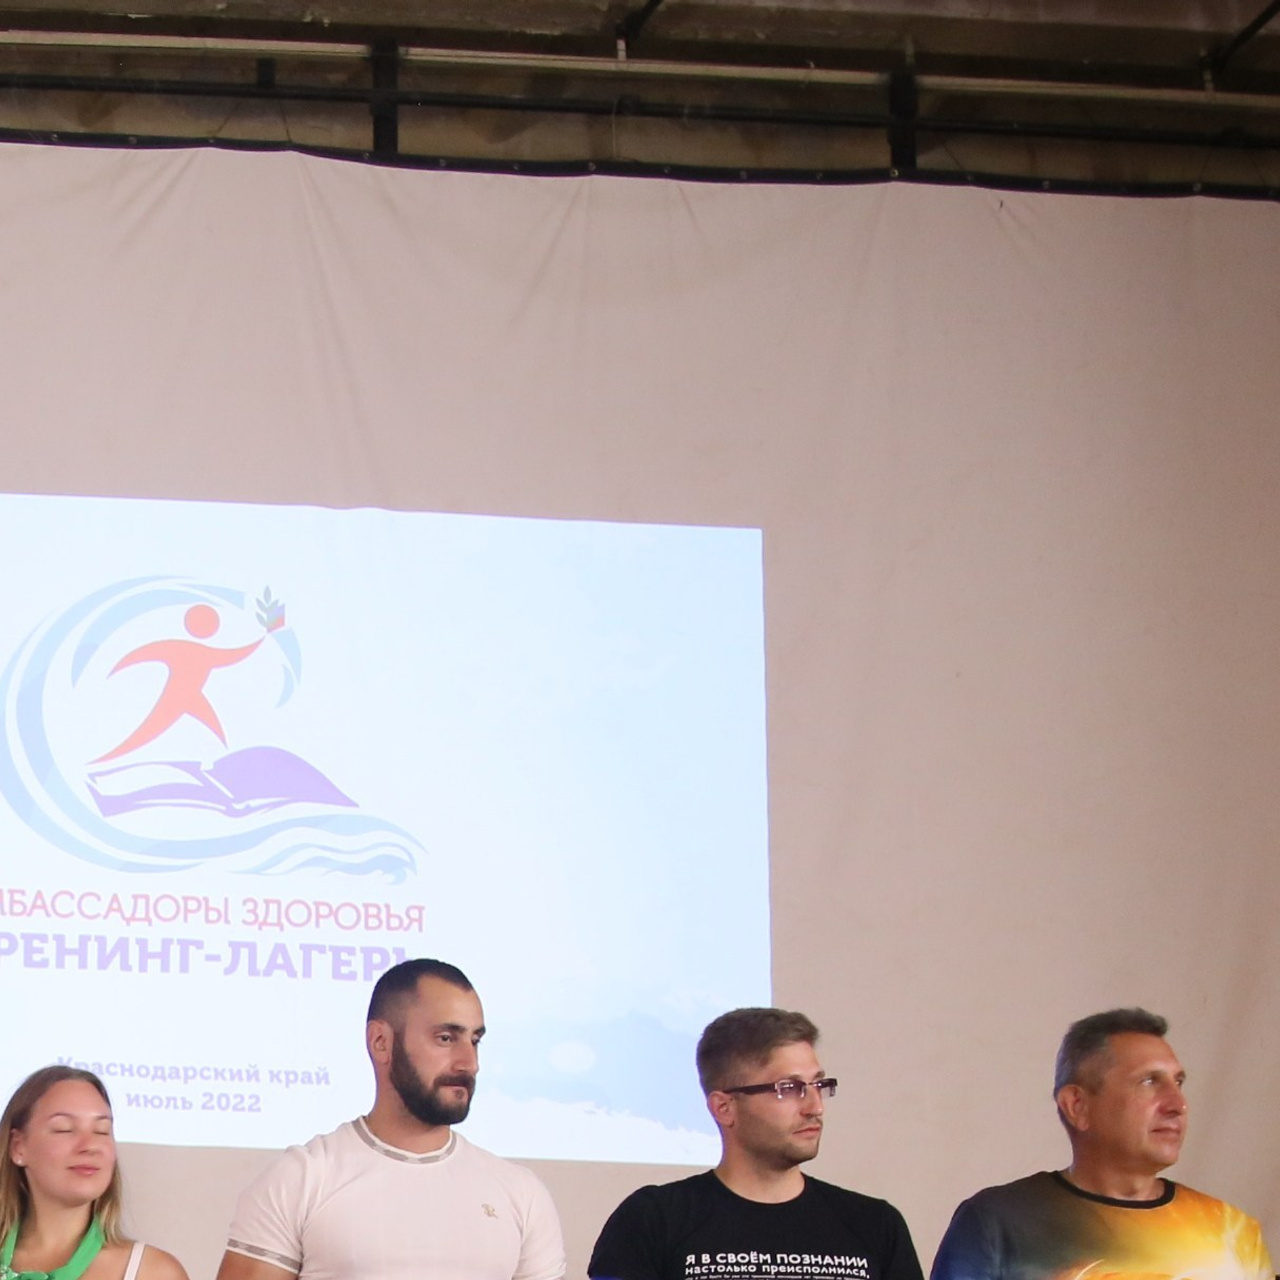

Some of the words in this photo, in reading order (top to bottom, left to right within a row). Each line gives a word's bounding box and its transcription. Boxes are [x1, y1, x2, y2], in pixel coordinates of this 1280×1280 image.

[241, 897, 426, 933] ЗДОРОВЬЯ
[269, 1066, 331, 1088] край
[126, 1092, 194, 1111] июль
[201, 1092, 262, 1113] 2022
[685, 1254, 695, 1266] Я
[701, 1253, 711, 1265] В
[716, 1251, 771, 1265] СВОЁМ
[776, 1253, 868, 1269] ПОЗНАНИИ
[685, 1264, 757, 1275] настолько
[762, 1265, 871, 1279] преисполнился,
